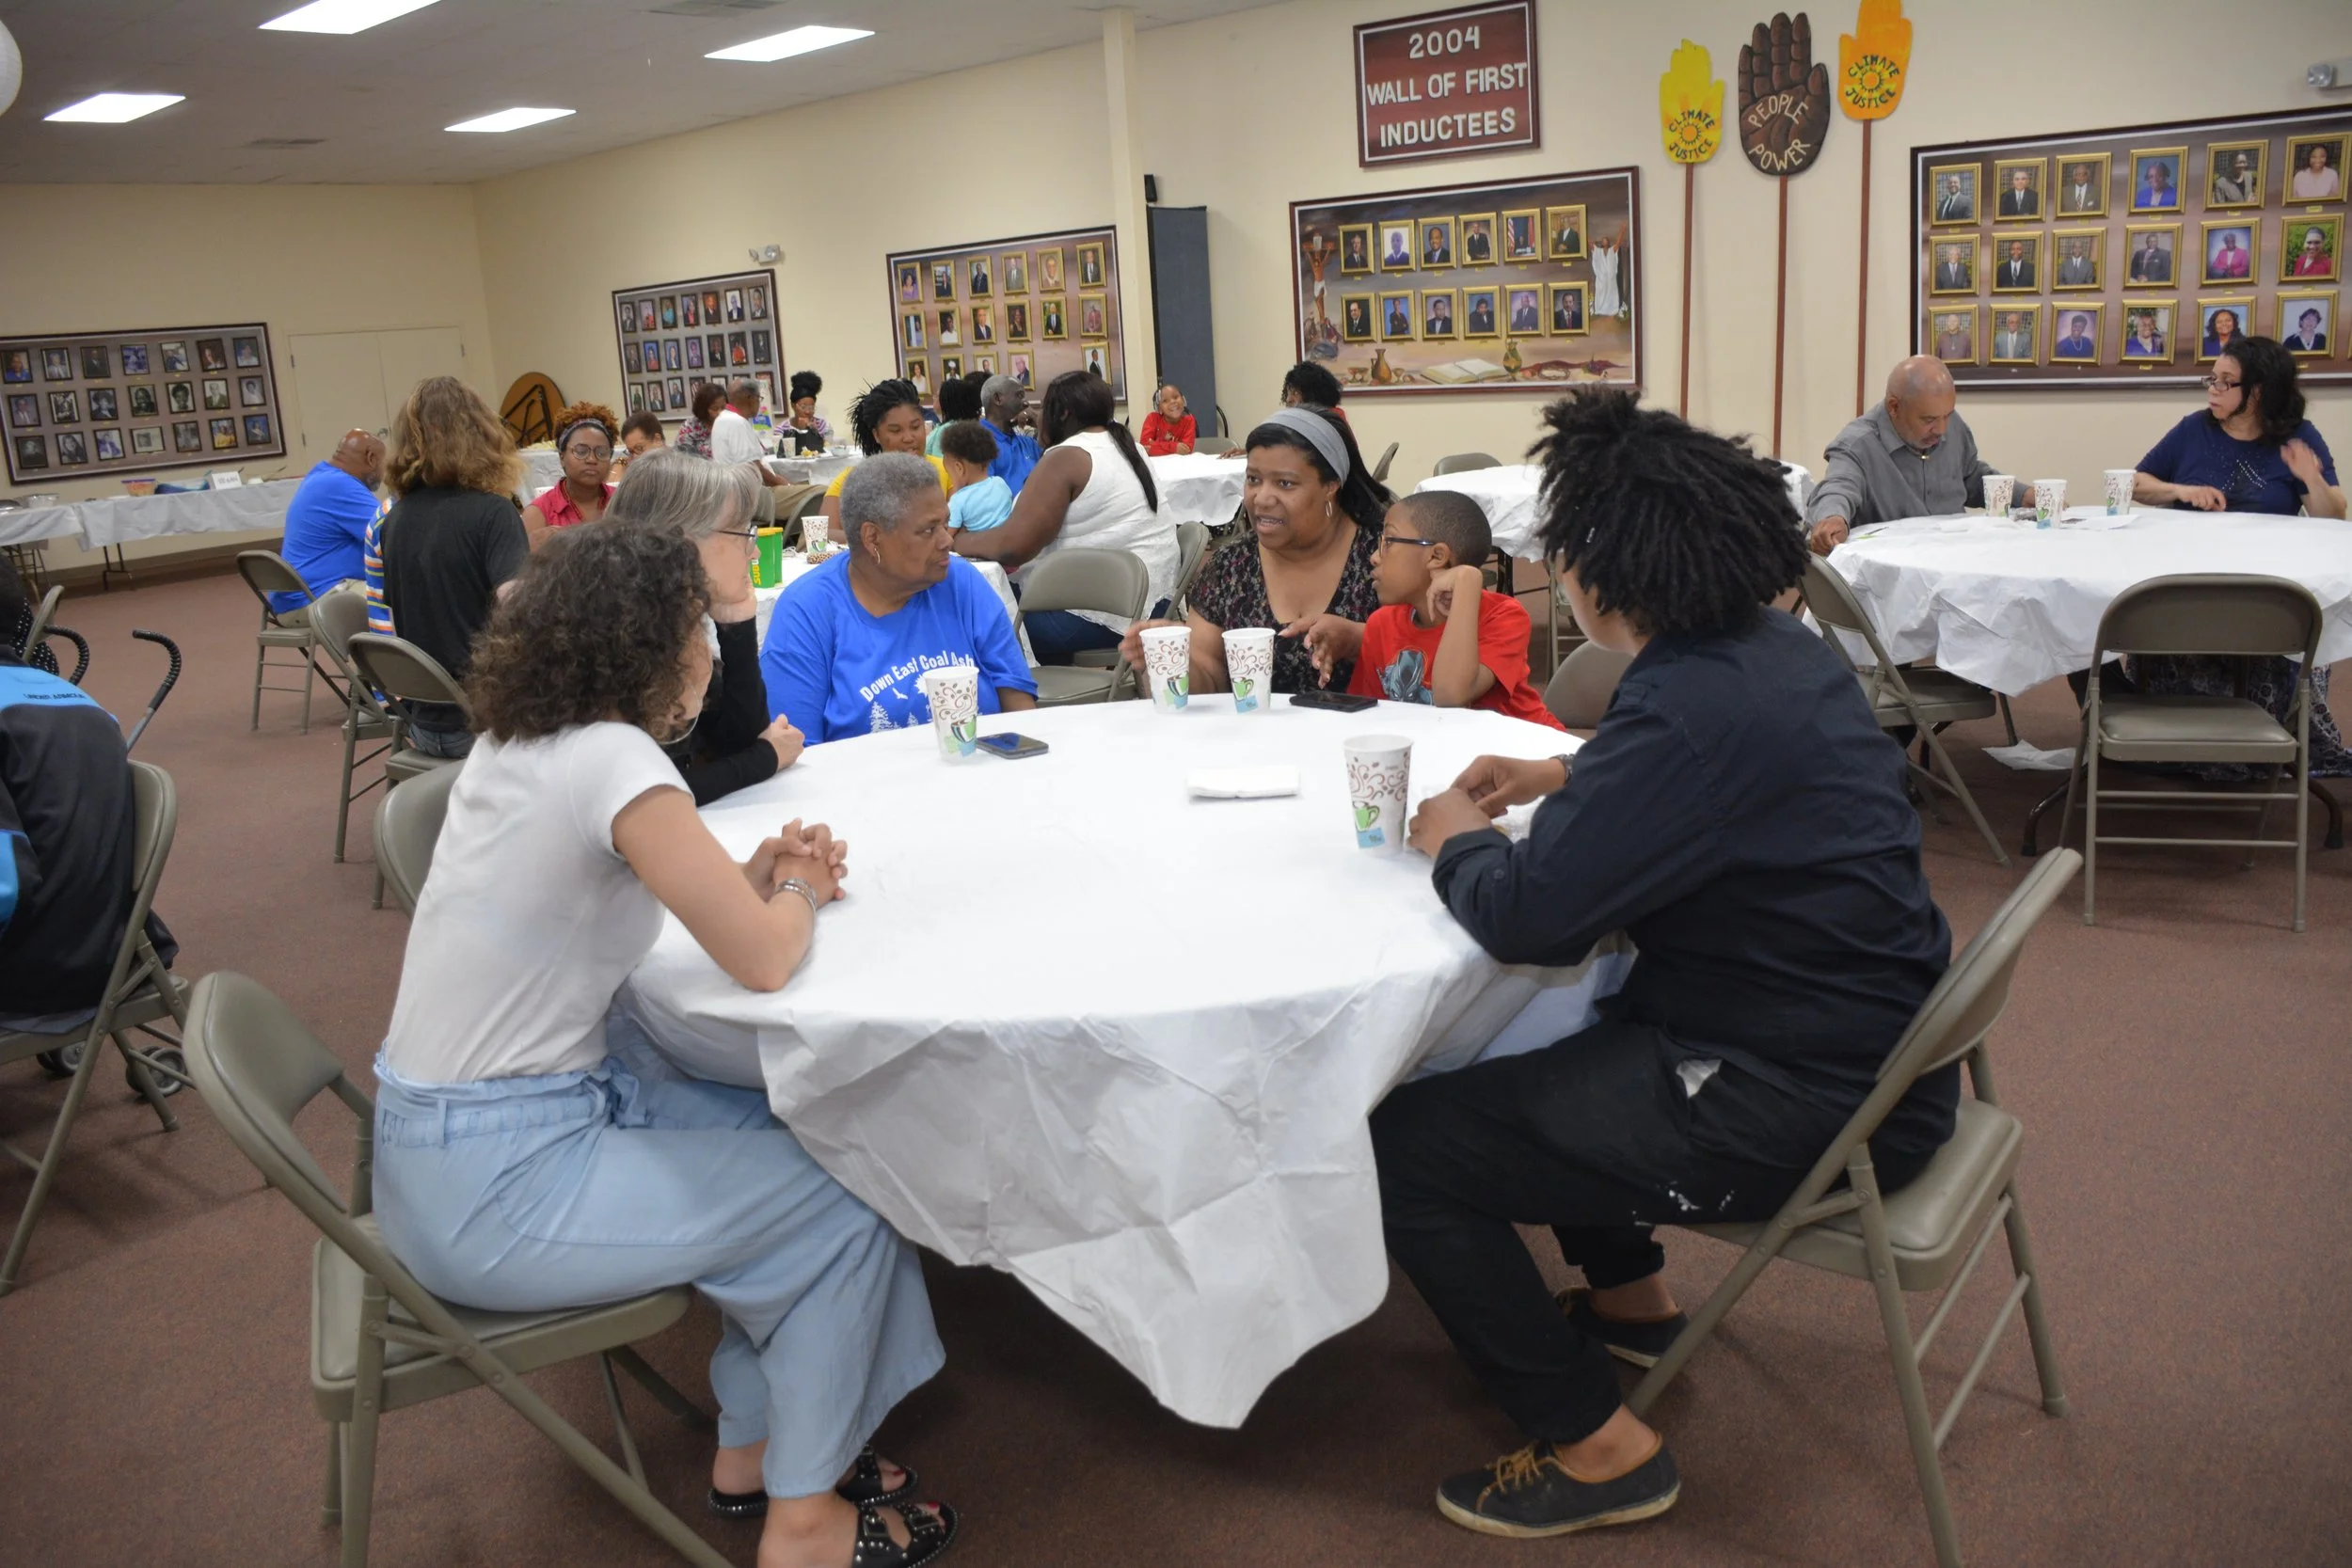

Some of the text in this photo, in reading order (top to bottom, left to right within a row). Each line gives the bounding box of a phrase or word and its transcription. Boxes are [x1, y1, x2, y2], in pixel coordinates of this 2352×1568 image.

[1409, 25, 1480, 59] 2004
[1848, 55, 1899, 77] CLIMATE
[1367, 62, 1528, 106] WALL OF FIRST
[1845, 87, 1897, 109] JUSTICE
[1380, 106, 1517, 148] INDUCTEES
[1669, 109, 1715, 133] CLIMATE
[1748, 93, 1809, 128] PEOPLE
[1669, 138, 1713, 160] JUSTICE
[1748, 138, 1811, 171] POWER
[859, 650, 975, 703] Down East Coal Ash
